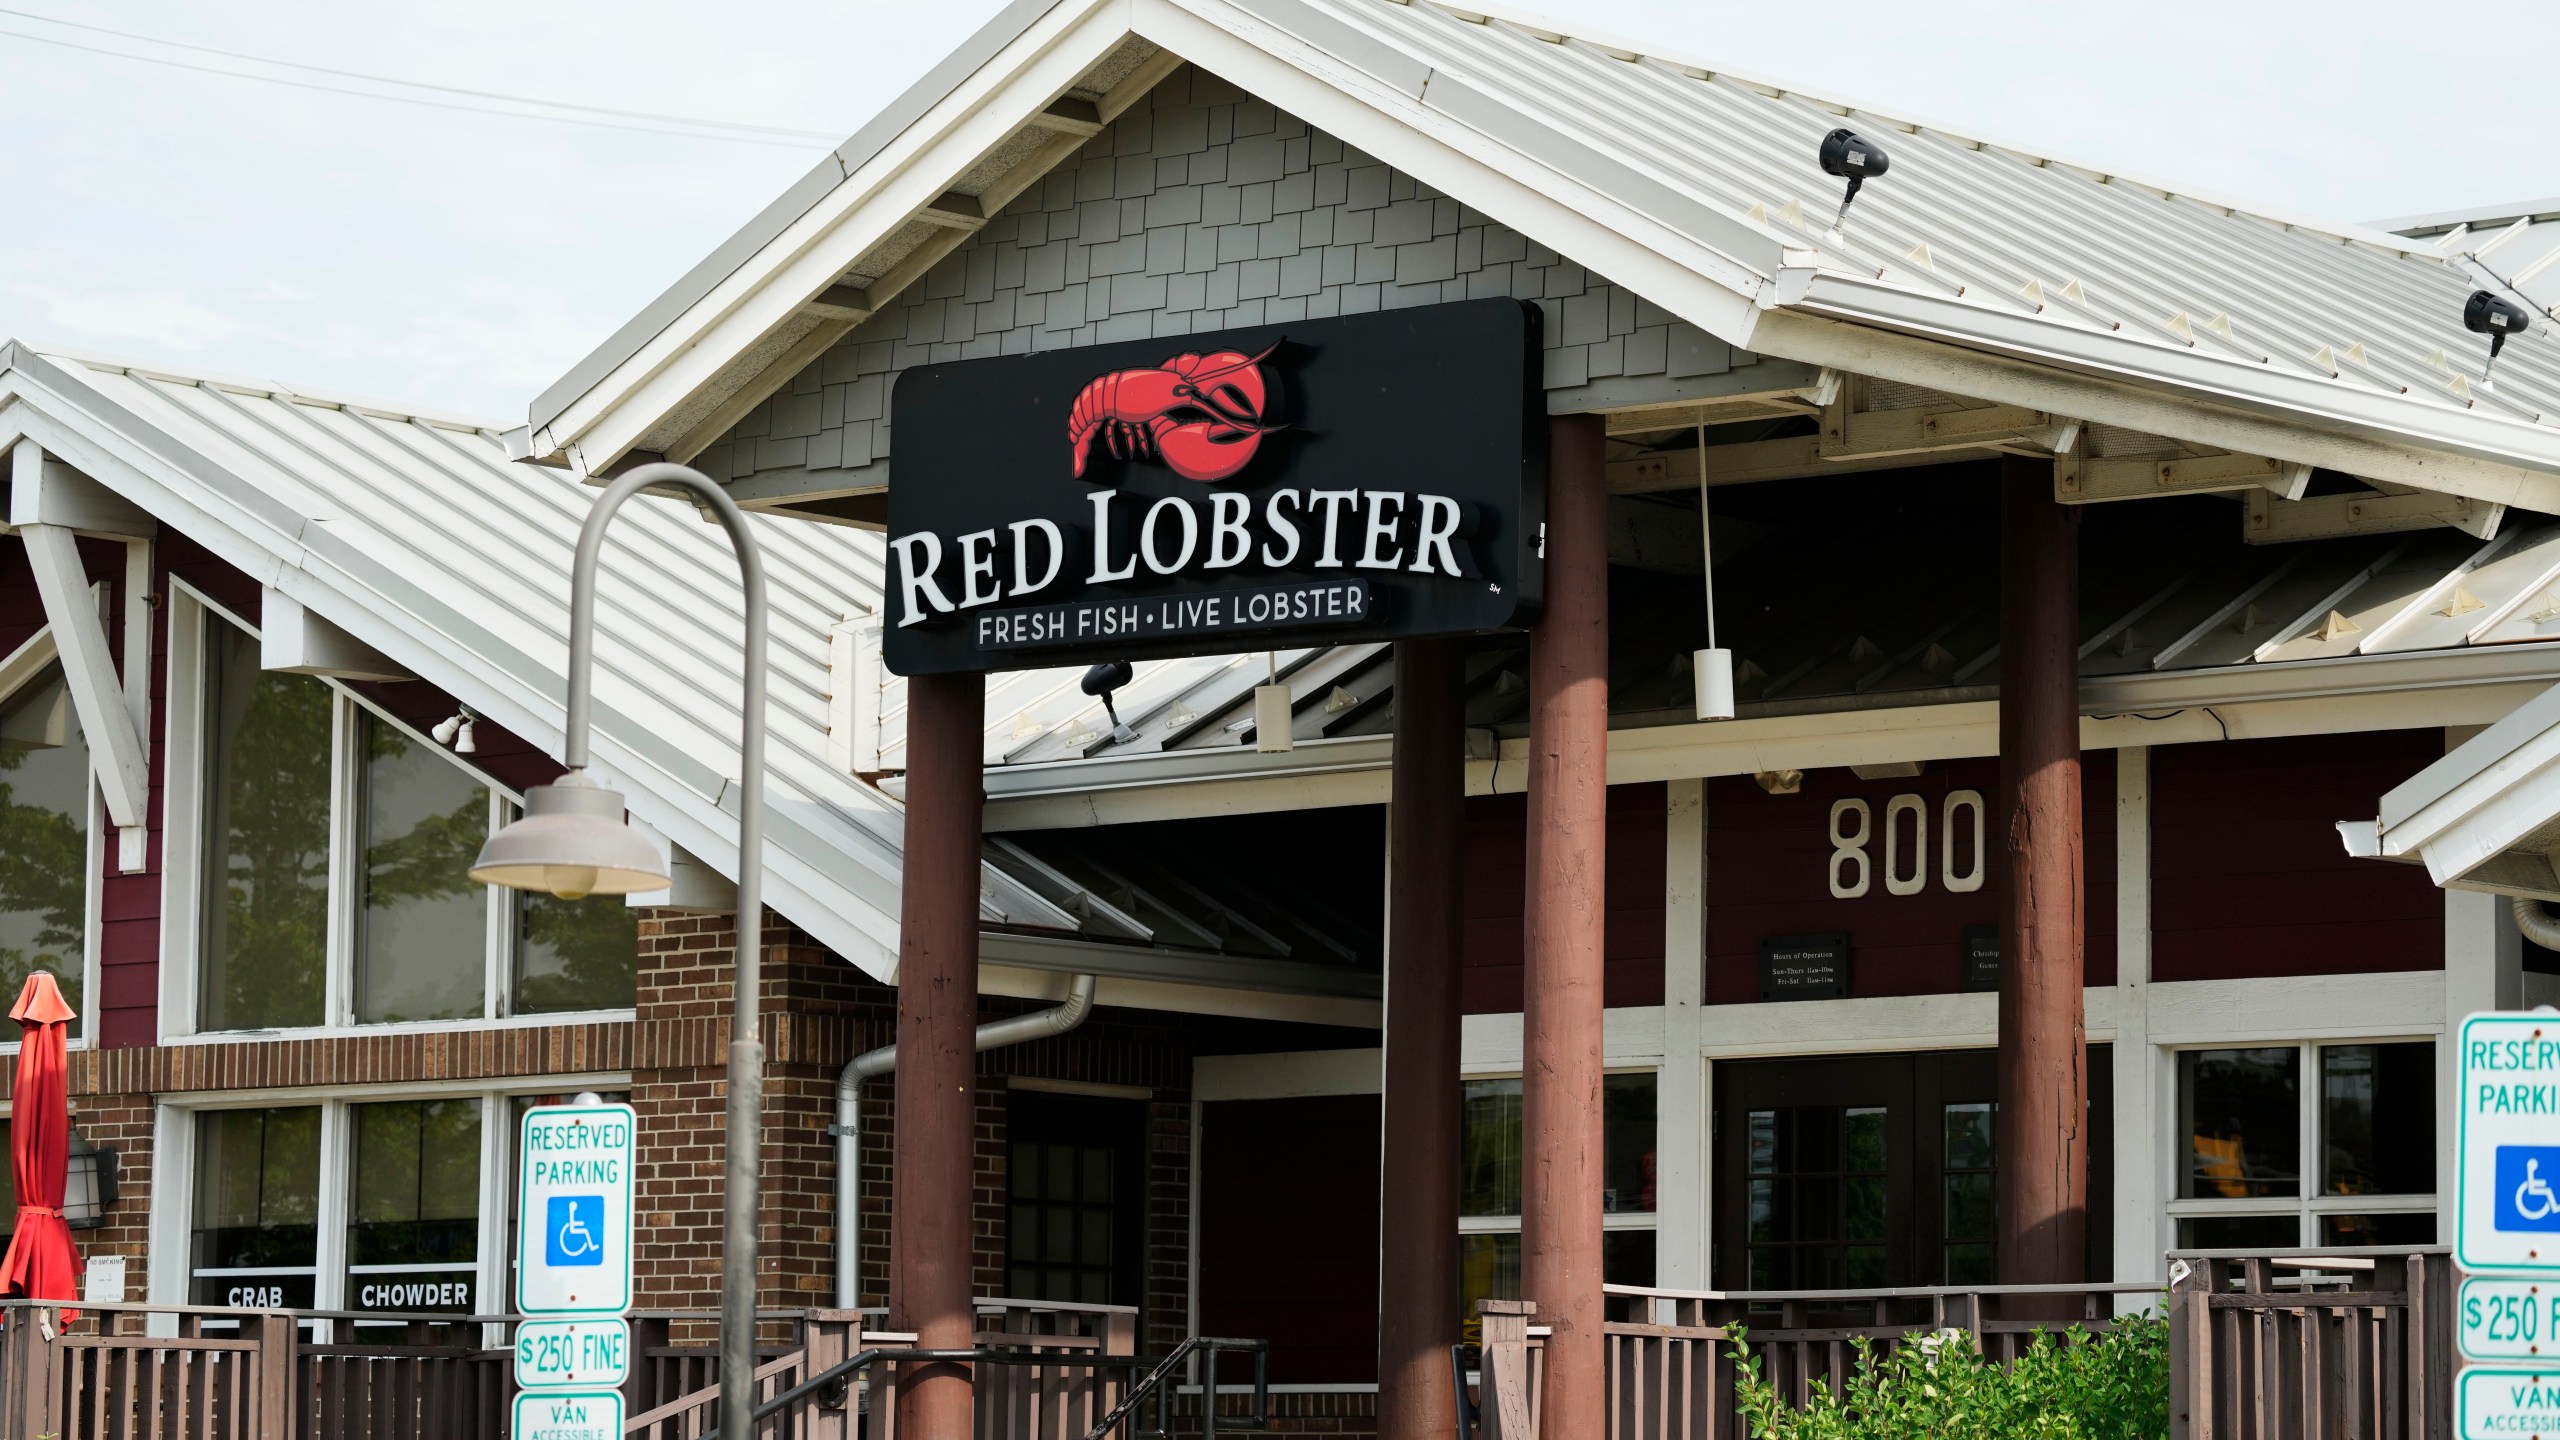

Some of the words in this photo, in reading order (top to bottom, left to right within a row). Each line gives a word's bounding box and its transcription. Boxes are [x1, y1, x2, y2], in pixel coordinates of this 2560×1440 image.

[889, 517, 1064, 629] RED
[1084, 487, 1463, 586] LOBSTER
[979, 611, 1065, 646] FRESH
[1078, 605, 1138, 637] FISH
[1162, 597, 1221, 630] LIVE
[1233, 585, 1363, 625] LOBSTER
[1829, 789, 1986, 900] 800
[1802, 952, 1833, 960] Operation
[1772, 967, 1804, 975] Sun-Thurs
[2471, 1040, 2560, 1070] RESER
[530, 1124, 626, 1151] RESERVED
[535, 1160, 618, 1185] PARKING
[228, 1286, 283, 1308] CRAB
[361, 1283, 468, 1307] CHOWDER
[583, 1333, 623, 1370] FINE
[2511, 1386, 2560, 1409] VAN
[551, 1405, 587, 1425] VAN
